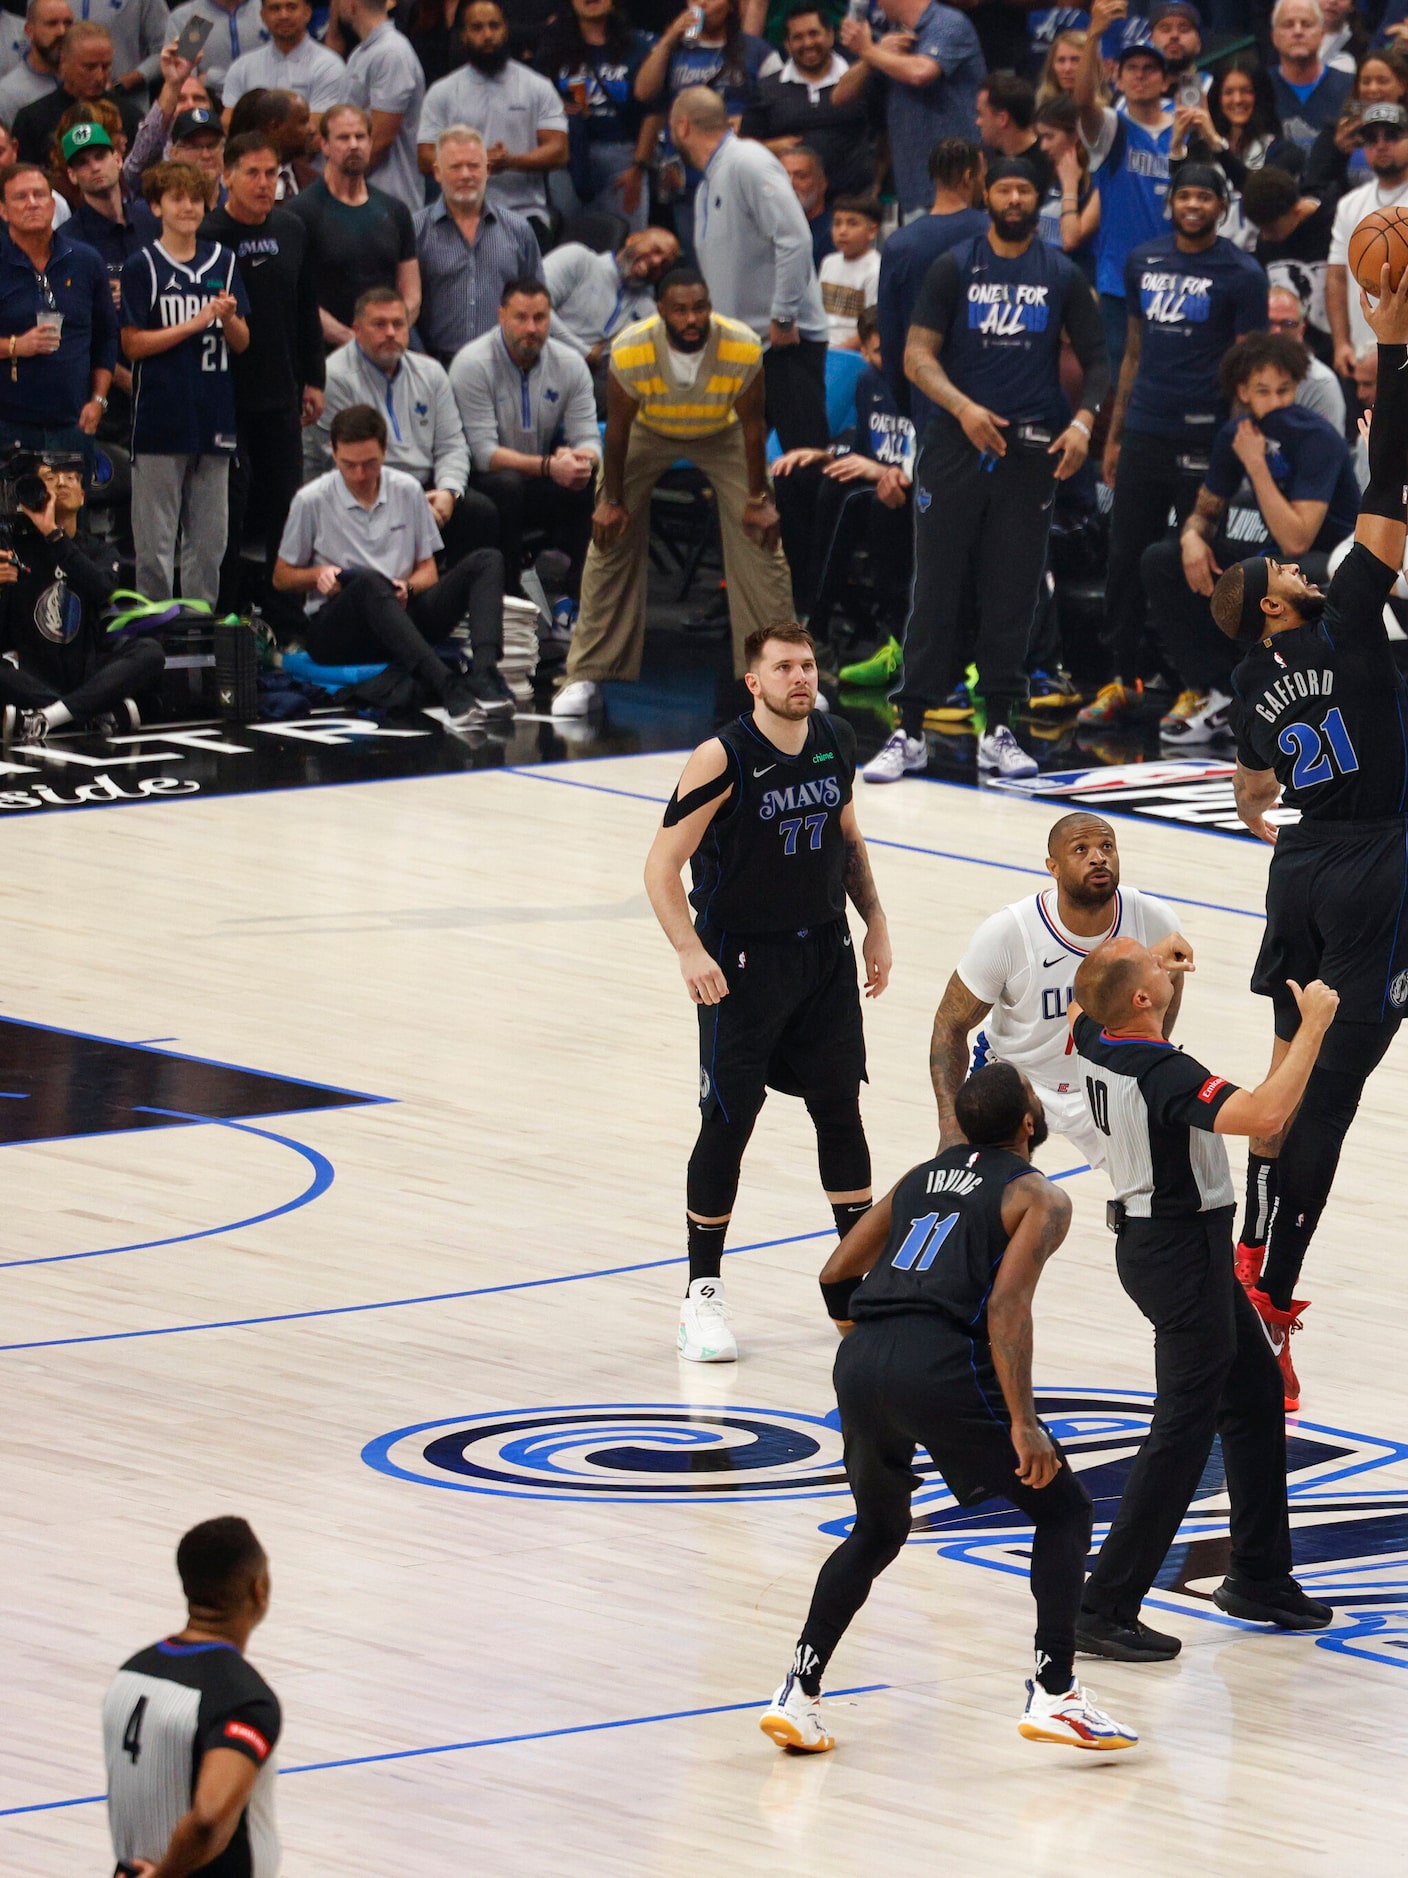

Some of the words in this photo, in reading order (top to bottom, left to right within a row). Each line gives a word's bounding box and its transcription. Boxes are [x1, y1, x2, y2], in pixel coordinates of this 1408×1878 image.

[239, 238, 279, 257] MAVS
[1016, 284, 1049, 306] FOR
[1180, 276, 1213, 298] FOR
[979, 303, 1025, 336] ALL
[1146, 291, 1186, 323] ALL
[201, 335, 229, 371] 21
[876, 432, 905, 464] ALL
[1255, 669, 1334, 724] GAFFORD
[812, 751, 834, 763] chime
[1277, 706, 1359, 790] 21
[759, 776, 841, 820] MAVS
[779, 812, 828, 855] 77
[1086, 1075, 1111, 1136] 10
[926, 1168, 983, 1196] IRVING
[891, 1211, 960, 1271] 11
[122, 1694, 148, 1767] 4
